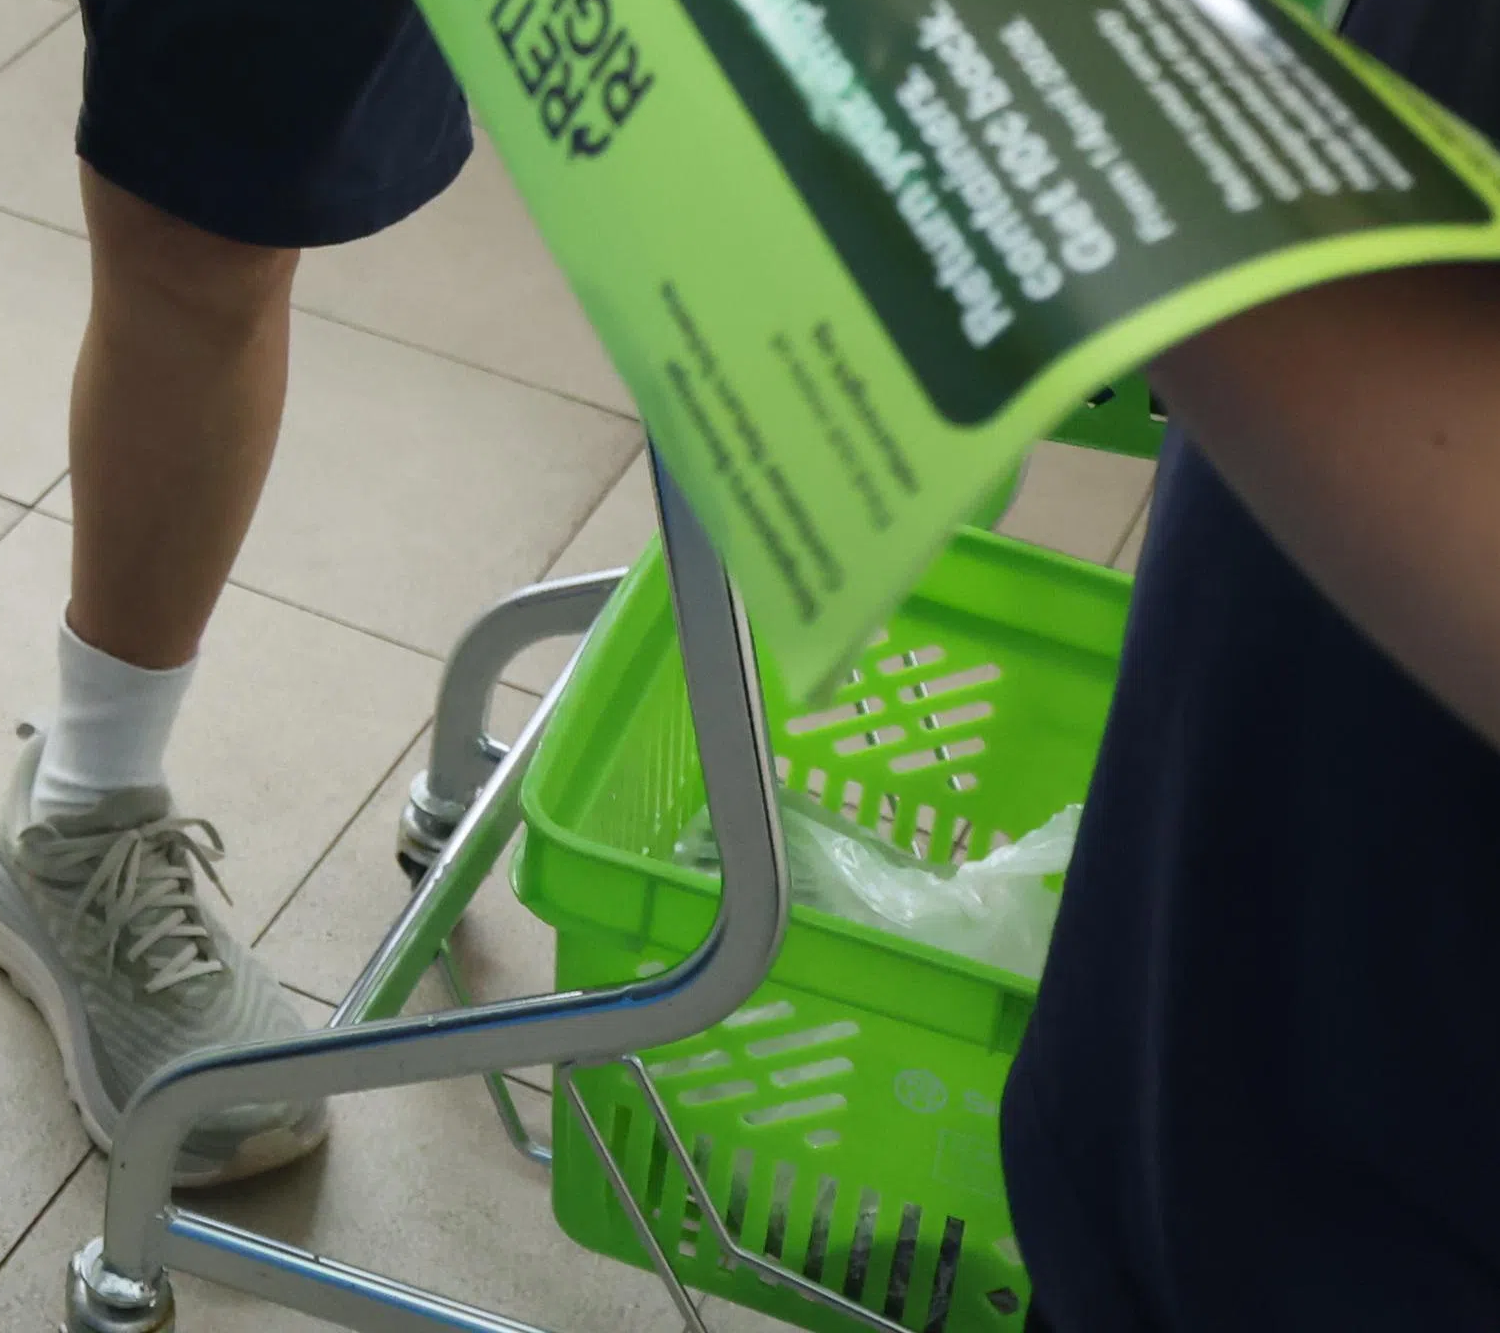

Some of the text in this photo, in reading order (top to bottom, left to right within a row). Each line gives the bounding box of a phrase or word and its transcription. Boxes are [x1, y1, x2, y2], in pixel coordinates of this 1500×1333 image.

[826, 88, 925, 193] your
[895, 66, 1065, 302] containers.
[1030, 177, 1119, 277] Get
[1102, 158, 1178, 248] From
[896, 179, 1013, 347] Return
